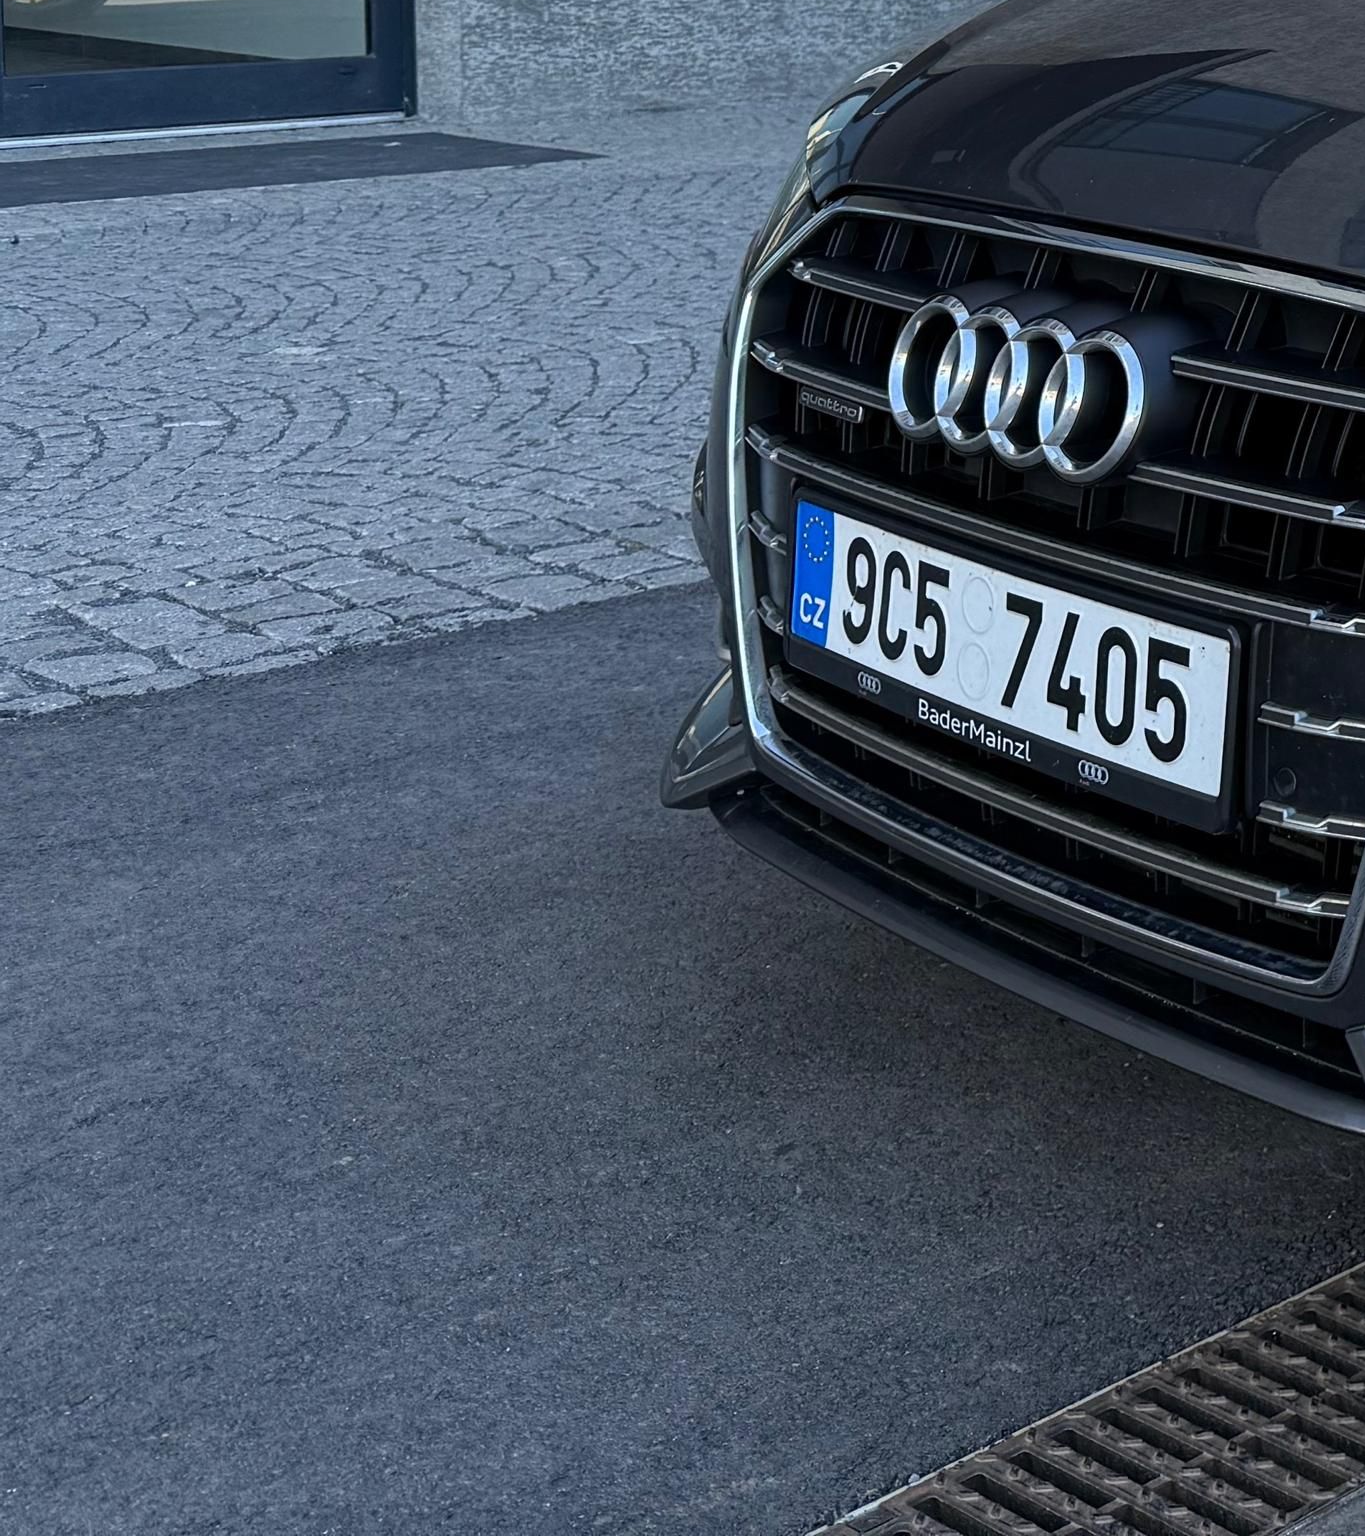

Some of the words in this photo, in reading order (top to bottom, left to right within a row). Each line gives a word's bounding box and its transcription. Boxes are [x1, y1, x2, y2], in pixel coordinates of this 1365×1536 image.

[801, 392, 857, 417] quattro
[799, 592, 826, 630] CZ
[842, 536, 950, 677] 9C5
[1000, 591, 1191, 764] 7405
